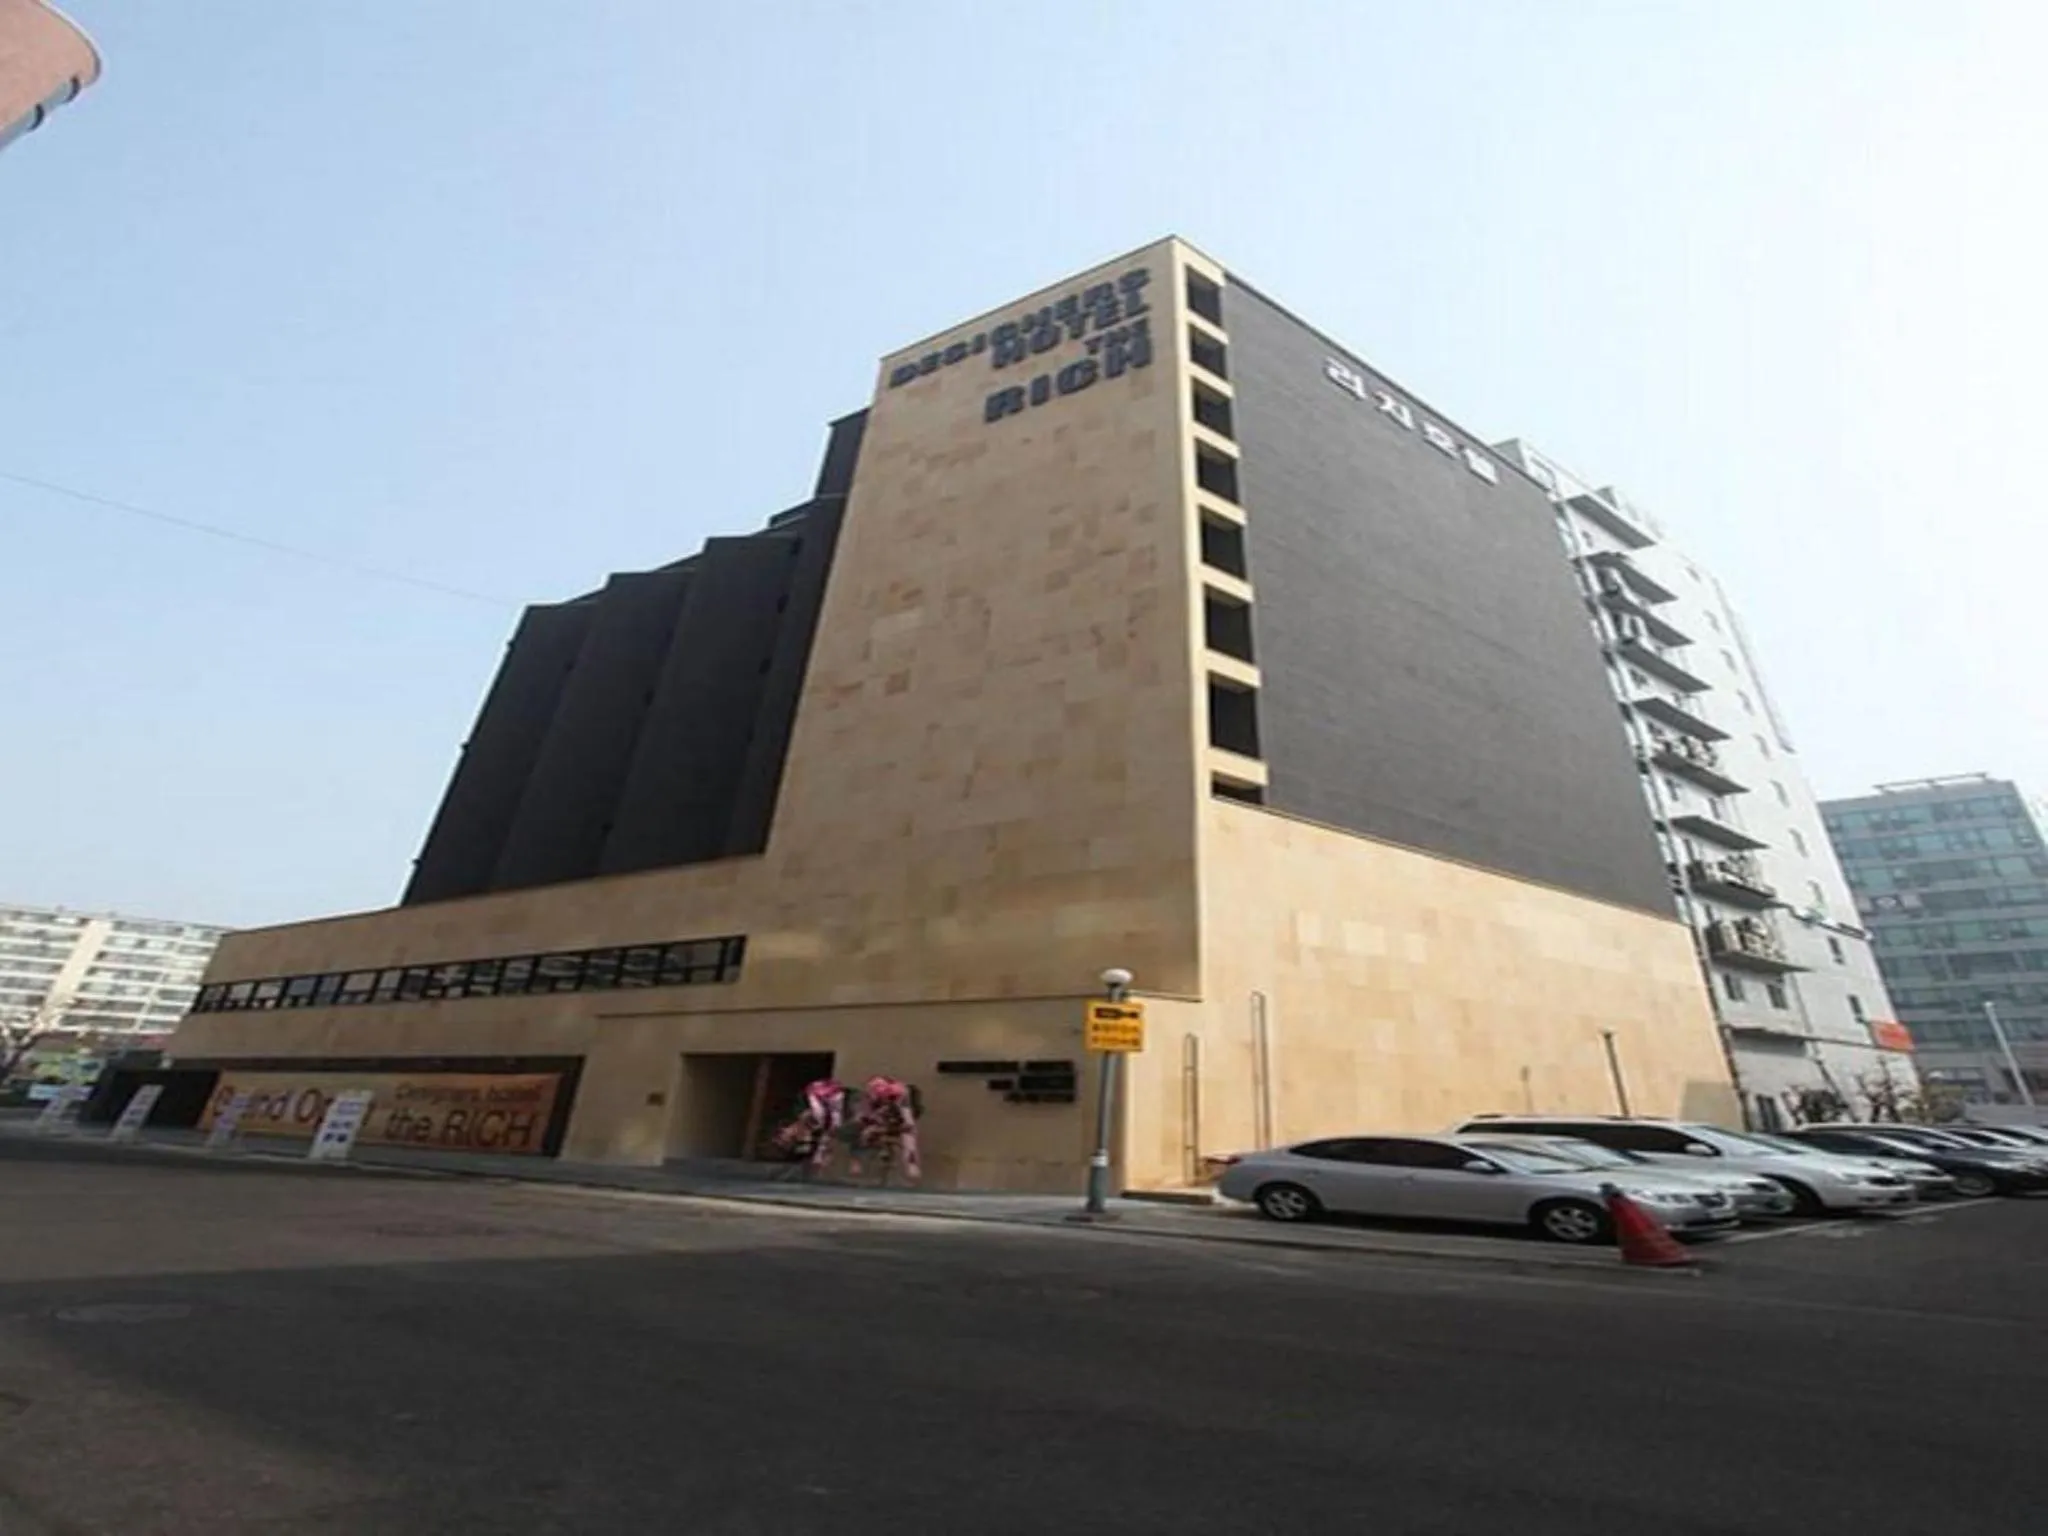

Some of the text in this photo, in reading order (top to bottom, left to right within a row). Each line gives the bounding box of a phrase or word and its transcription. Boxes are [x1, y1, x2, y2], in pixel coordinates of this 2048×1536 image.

[992, 291, 1151, 369] HOTEL
[984, 335, 1152, 423] RICH
[440, 1109, 538, 1147] RICH
